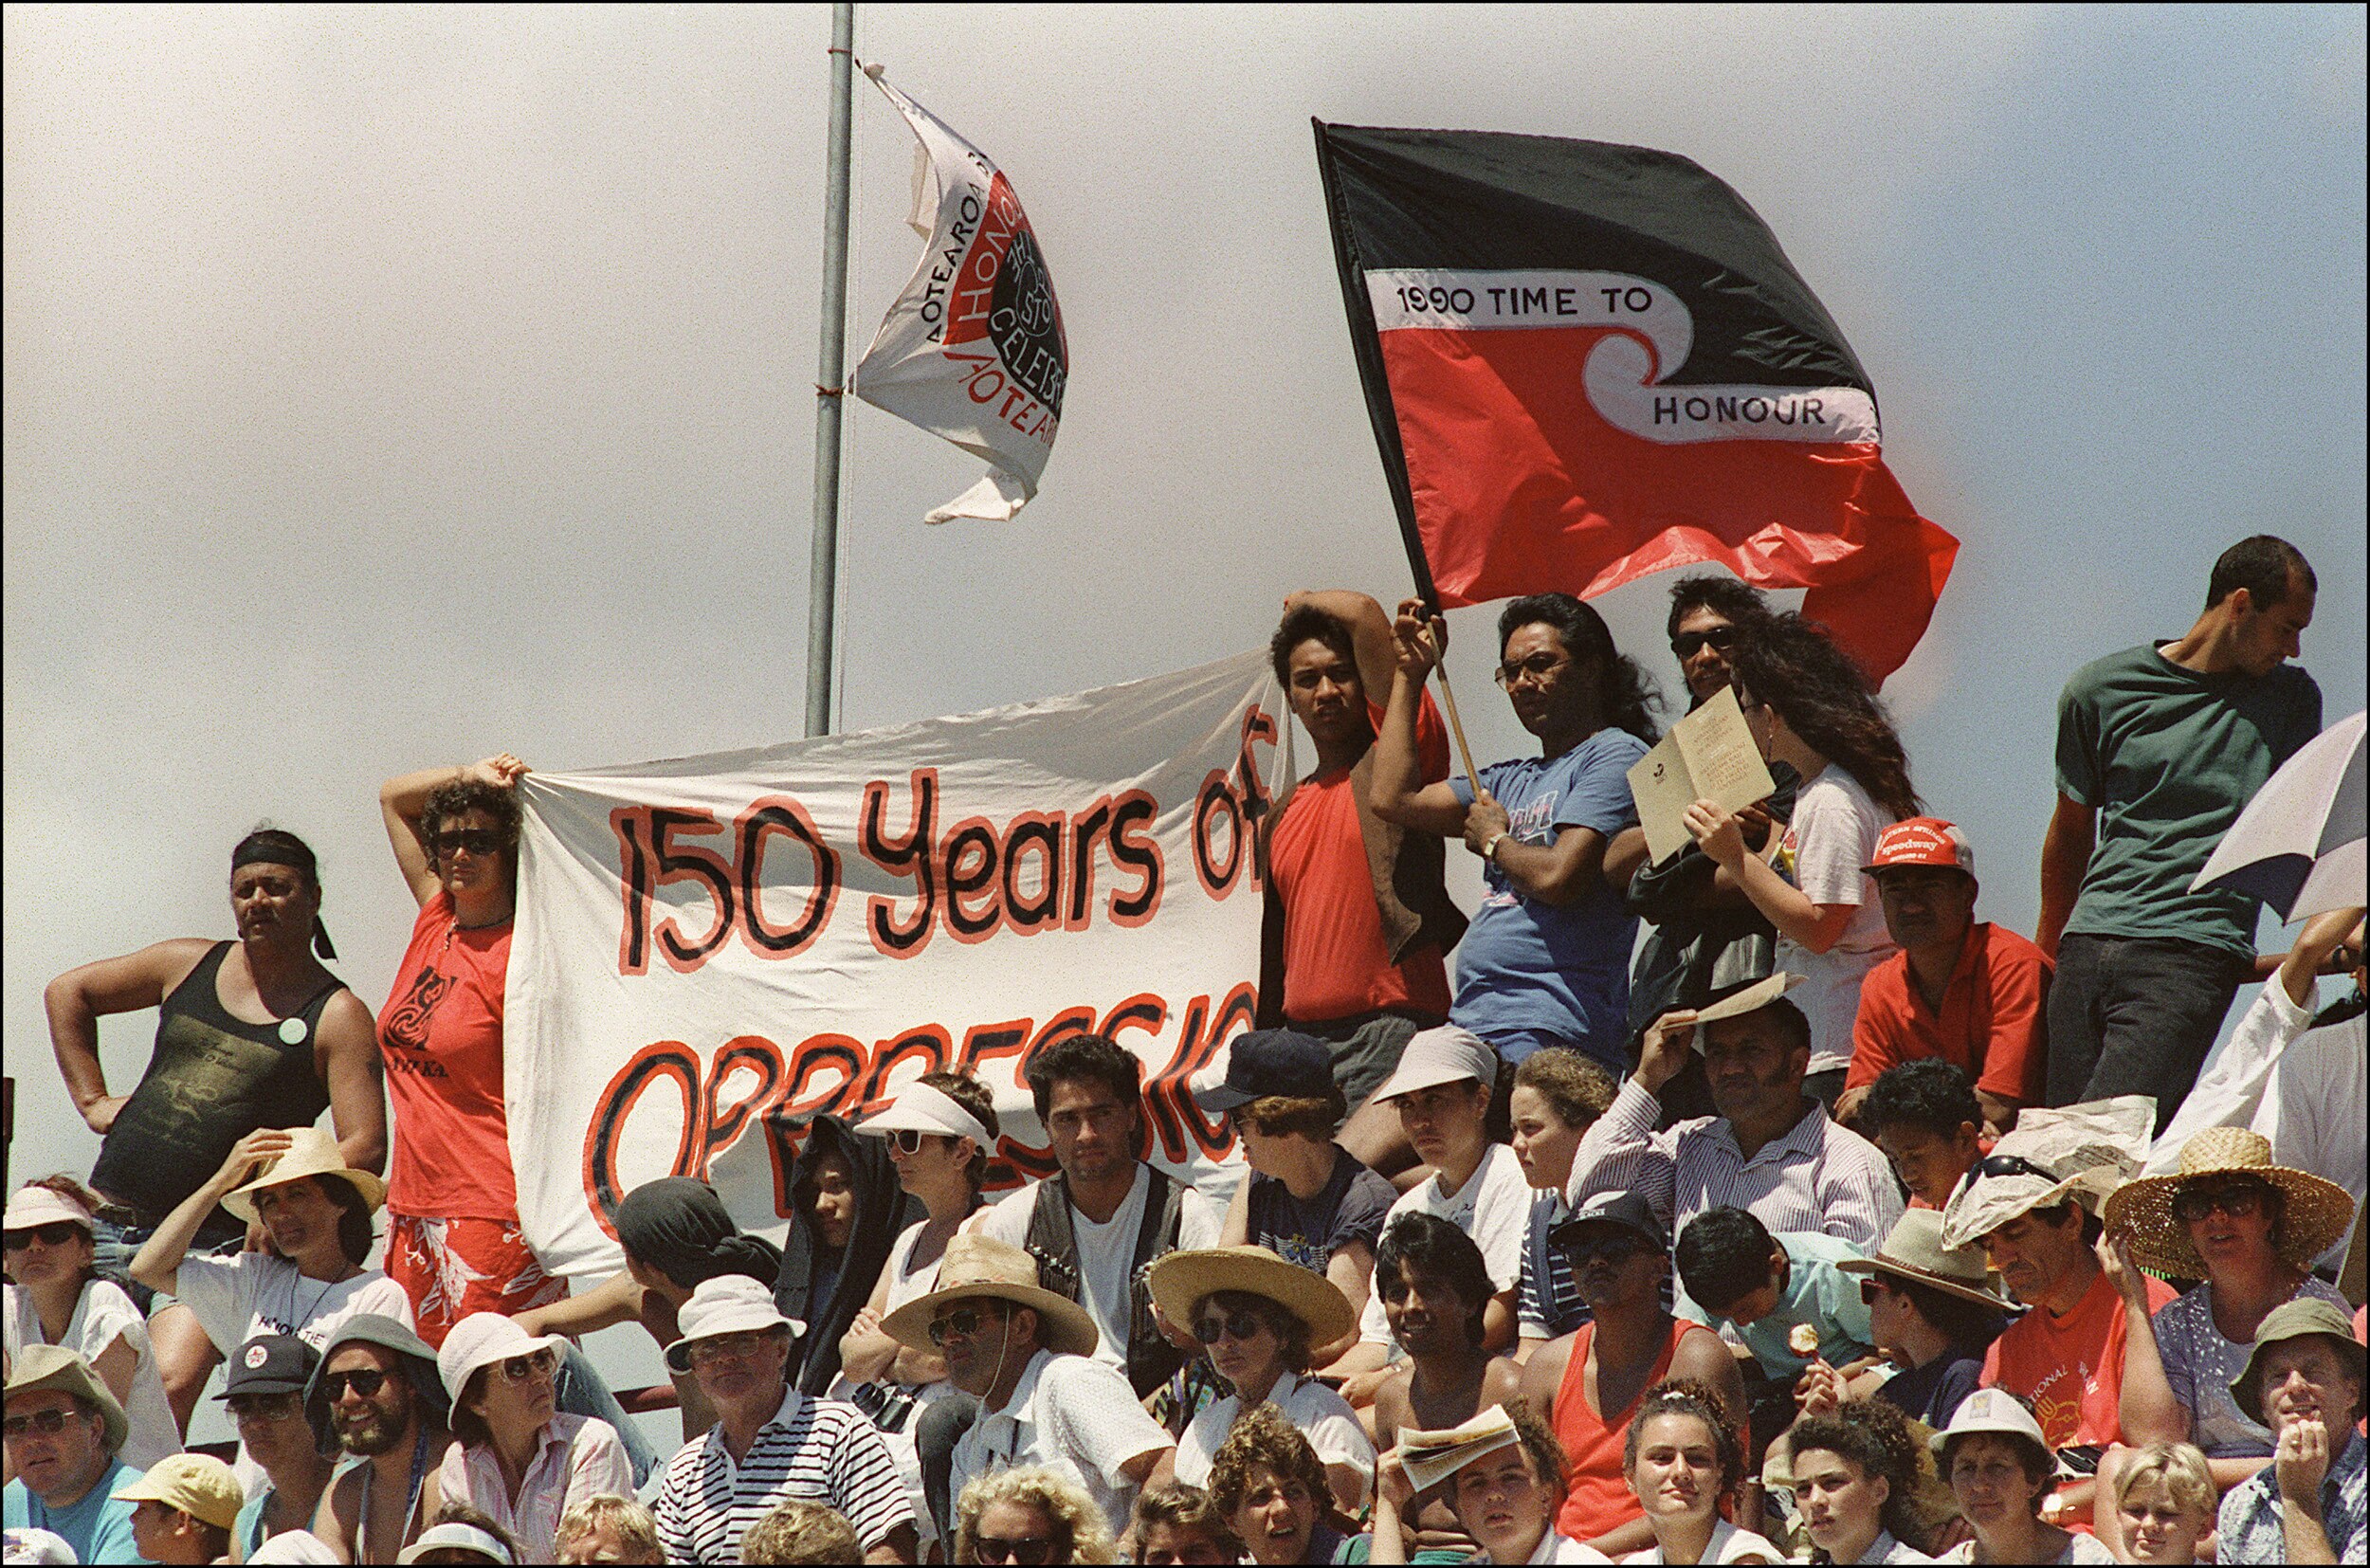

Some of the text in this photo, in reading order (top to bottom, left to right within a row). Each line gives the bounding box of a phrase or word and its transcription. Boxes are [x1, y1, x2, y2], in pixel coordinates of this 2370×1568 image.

[921, 181, 985, 342] AOTEAROA
[1396, 286, 1652, 316] 1990 TIME TO
[1653, 395, 1826, 426] HONOUR
[610, 794, 843, 976] 150
[1191, 703, 1278, 901] of
[1882, 838, 1939, 856] speedway
